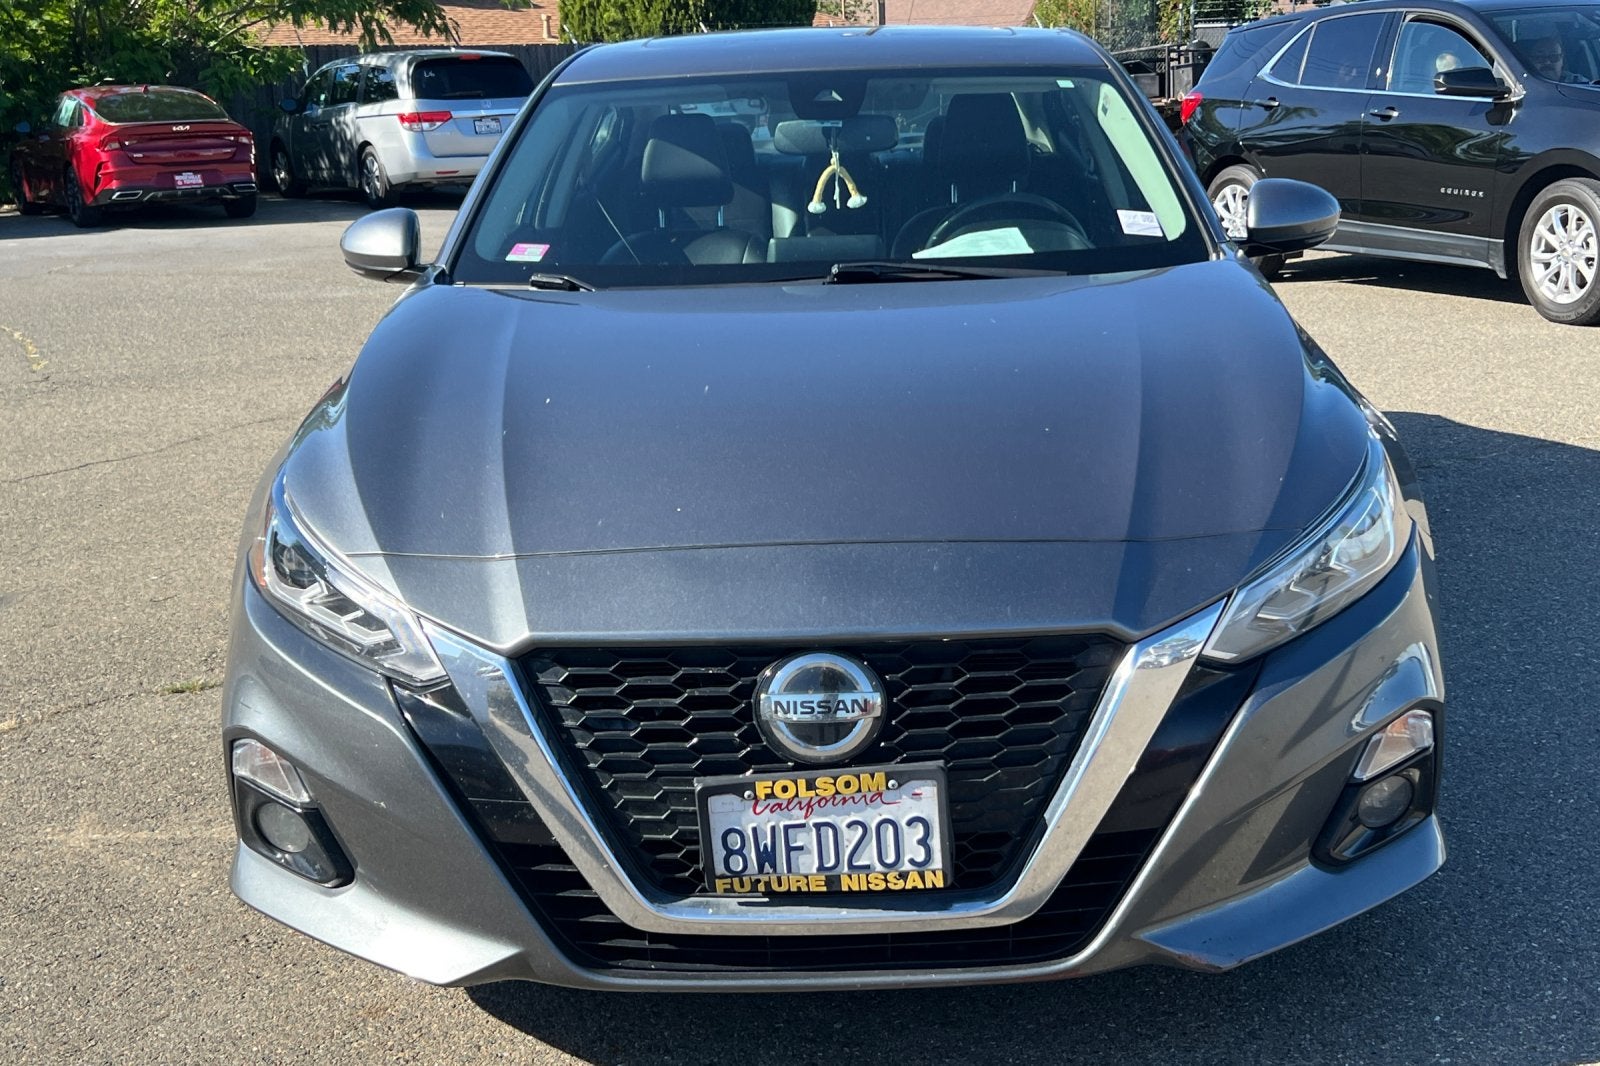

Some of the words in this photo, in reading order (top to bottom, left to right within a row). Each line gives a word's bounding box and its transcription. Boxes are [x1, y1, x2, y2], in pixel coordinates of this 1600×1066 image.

[773, 698, 869, 715] NISSAN
[755, 771, 887, 800] FOLSOM
[752, 791, 901, 819] California
[720, 815, 932, 875] 8WFD203
[715, 875, 827, 894] FUTURE
[841, 870, 945, 891] NISSAN
